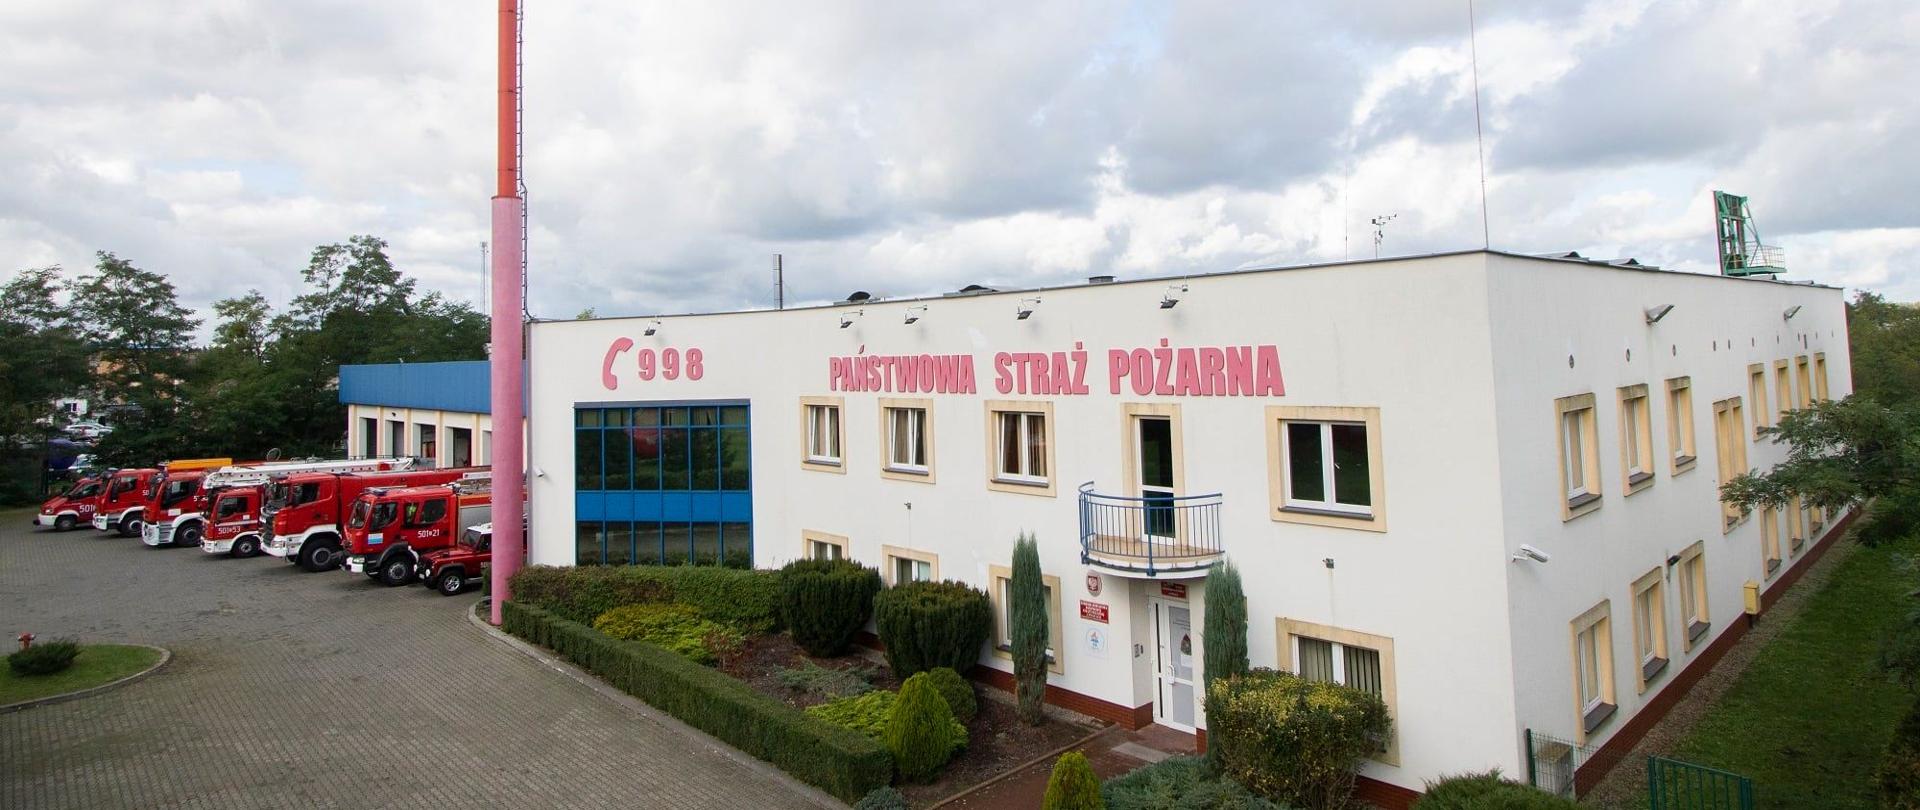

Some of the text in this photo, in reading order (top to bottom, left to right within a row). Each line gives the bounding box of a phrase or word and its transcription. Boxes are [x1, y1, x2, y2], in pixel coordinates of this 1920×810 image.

[638, 347, 704, 381] 998
[829, 338, 1285, 397] PAŃSTWOWA STRAŻ POŻARNA
